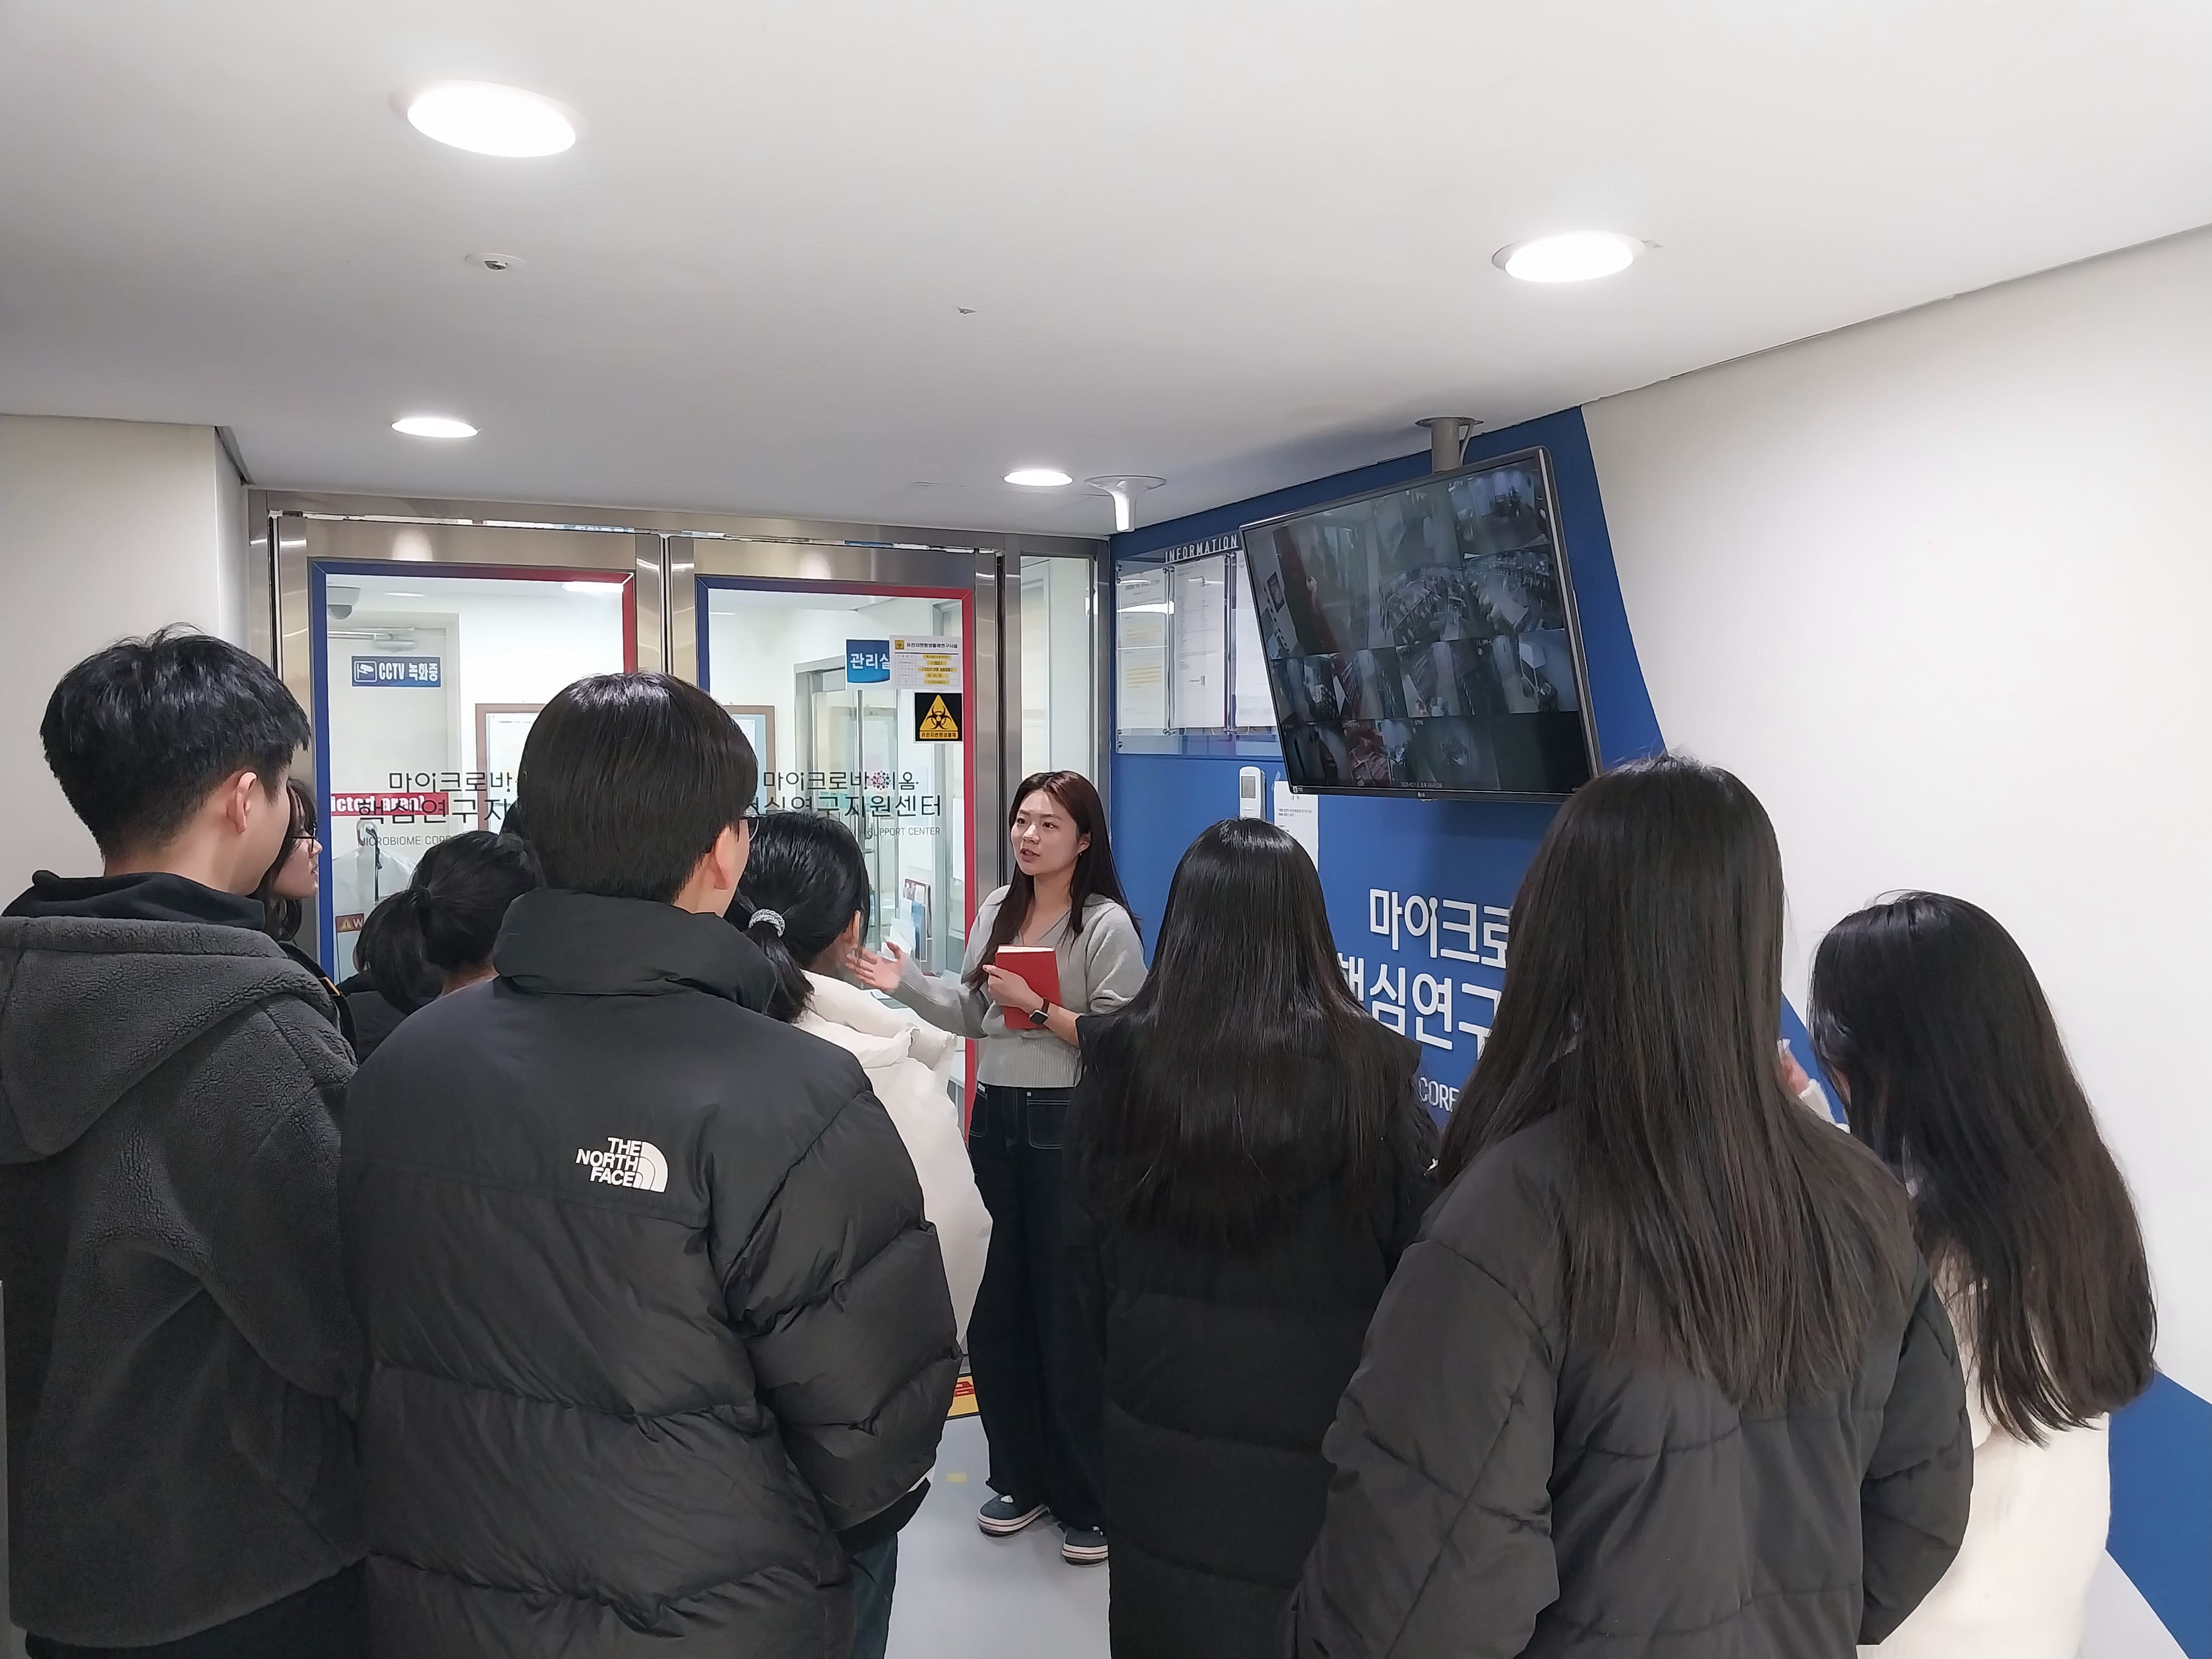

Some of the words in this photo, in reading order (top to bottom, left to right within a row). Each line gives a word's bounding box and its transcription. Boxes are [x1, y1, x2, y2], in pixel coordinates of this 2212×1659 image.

[1164, 533, 1238, 563] INFORMATION
[379, 663, 405, 680] CCTV
[409, 663, 439, 681] 녹화중
[908, 827, 941, 835] CENTER
[607, 1137, 642, 1157] THE
[575, 1148, 639, 1172] NORTH
[589, 1166, 635, 1187] FACE
